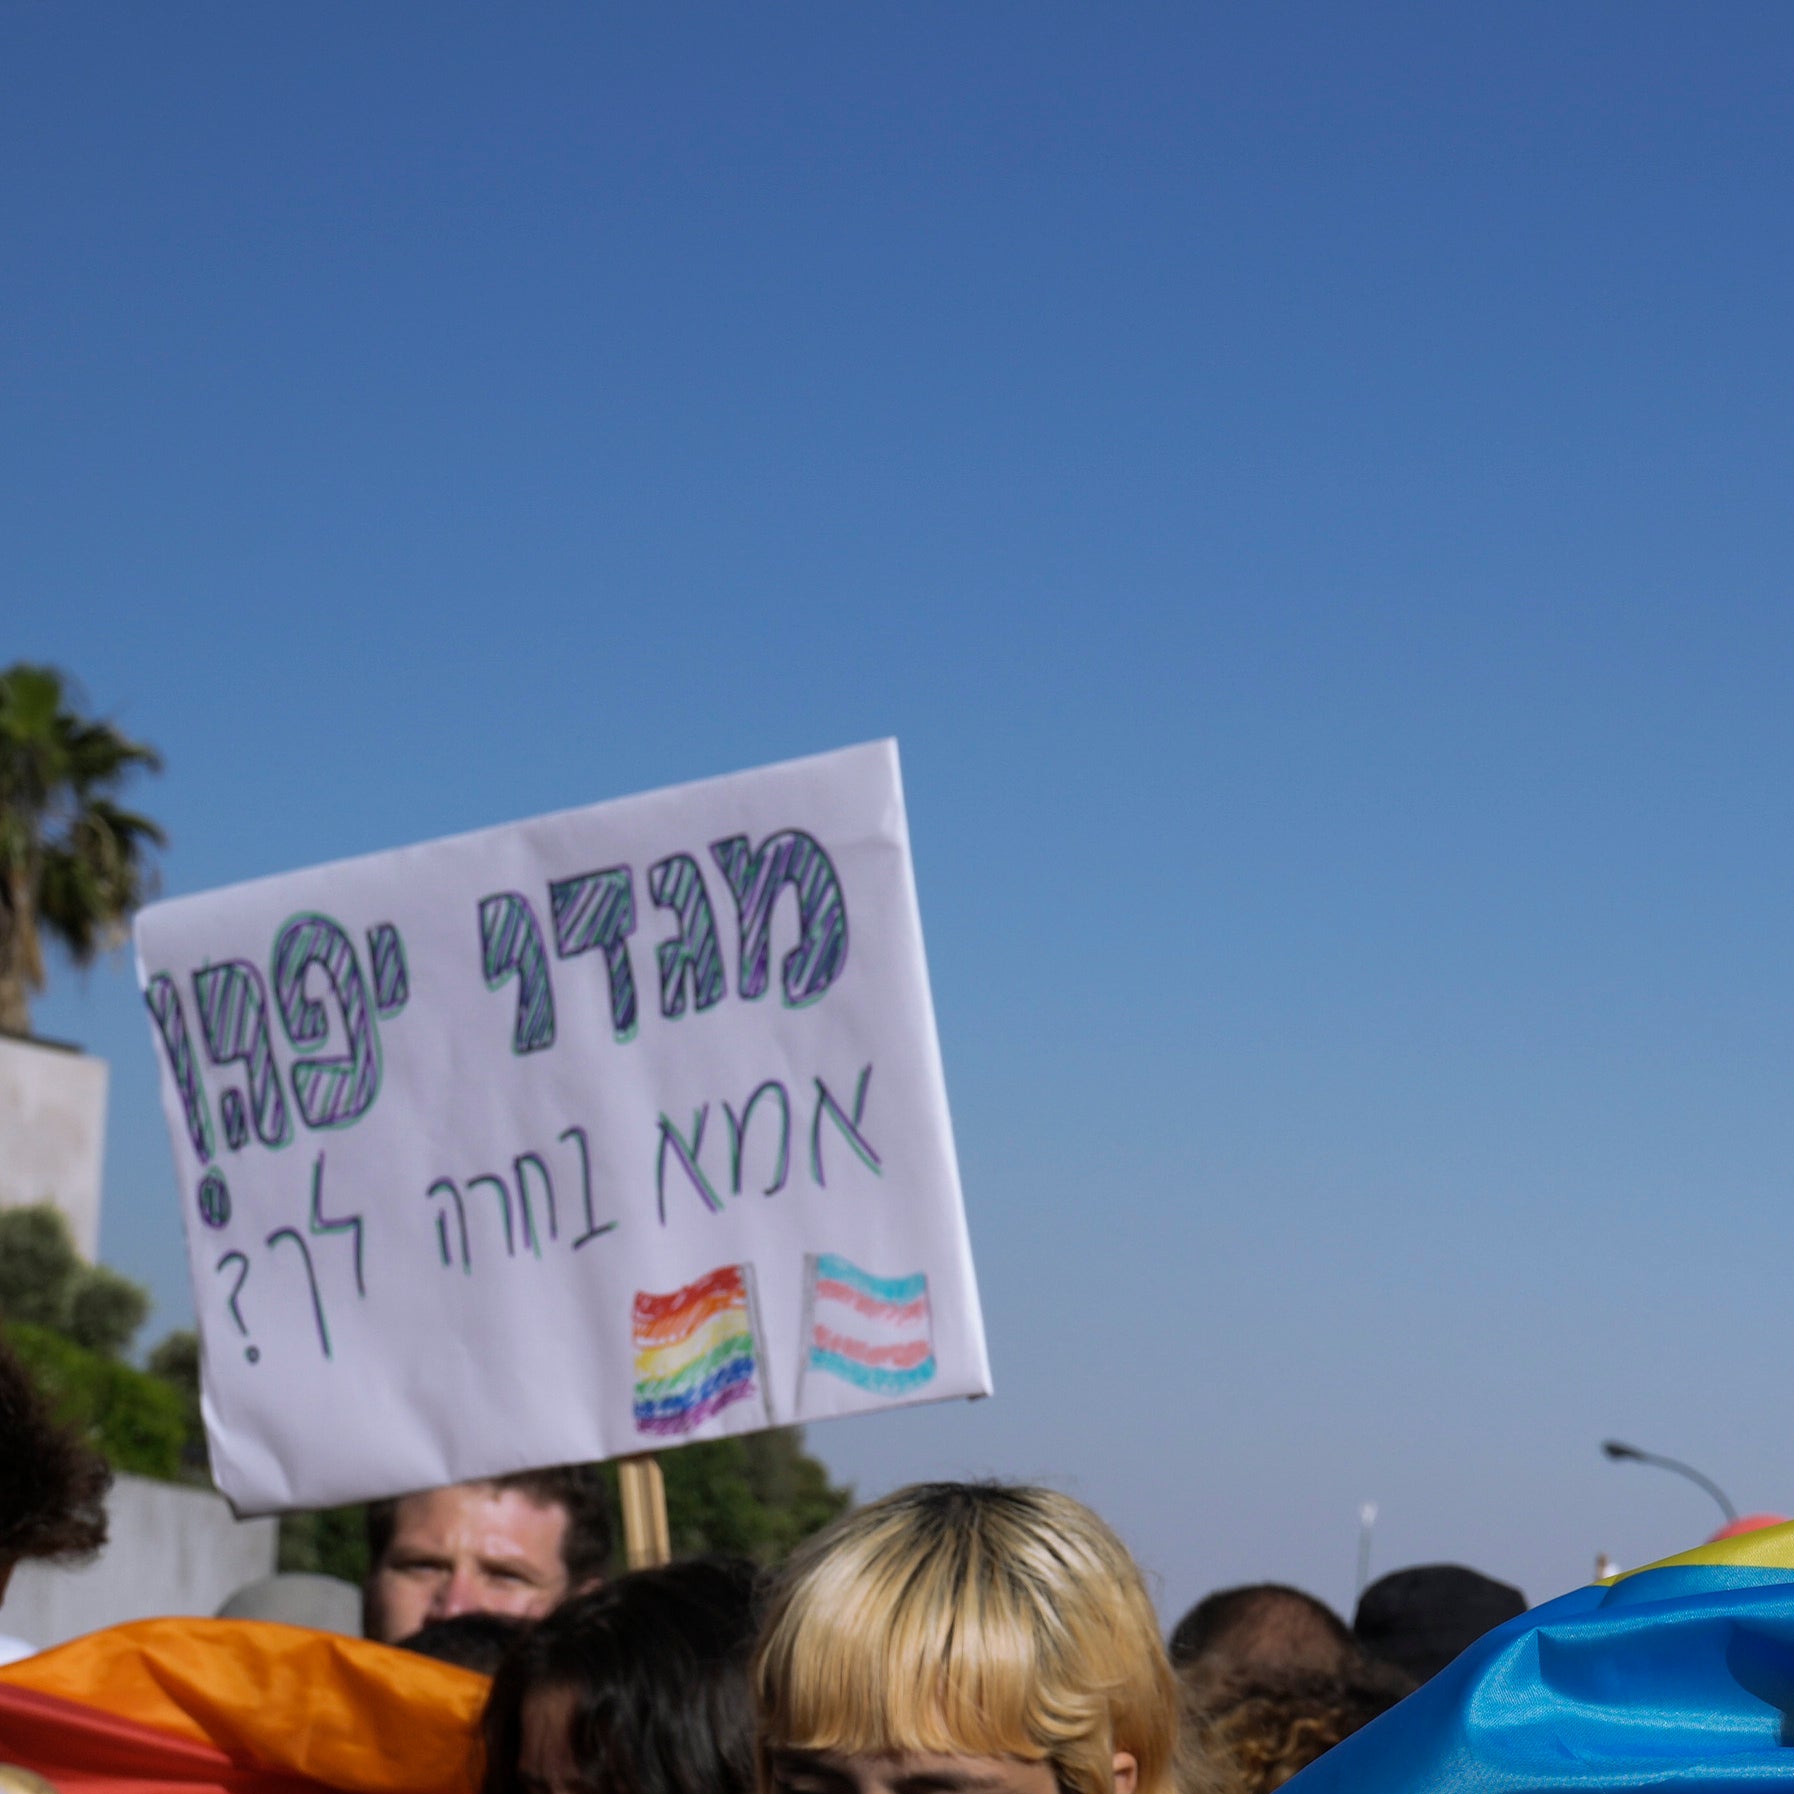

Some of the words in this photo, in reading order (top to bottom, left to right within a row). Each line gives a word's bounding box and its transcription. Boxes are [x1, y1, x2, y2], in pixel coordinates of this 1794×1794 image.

[477, 826, 850, 1057] מגדר
[426, 1123, 617, 1276] בחרה
[655, 1063, 883, 1227] אמא
[215, 1149, 366, 1364] לך?
